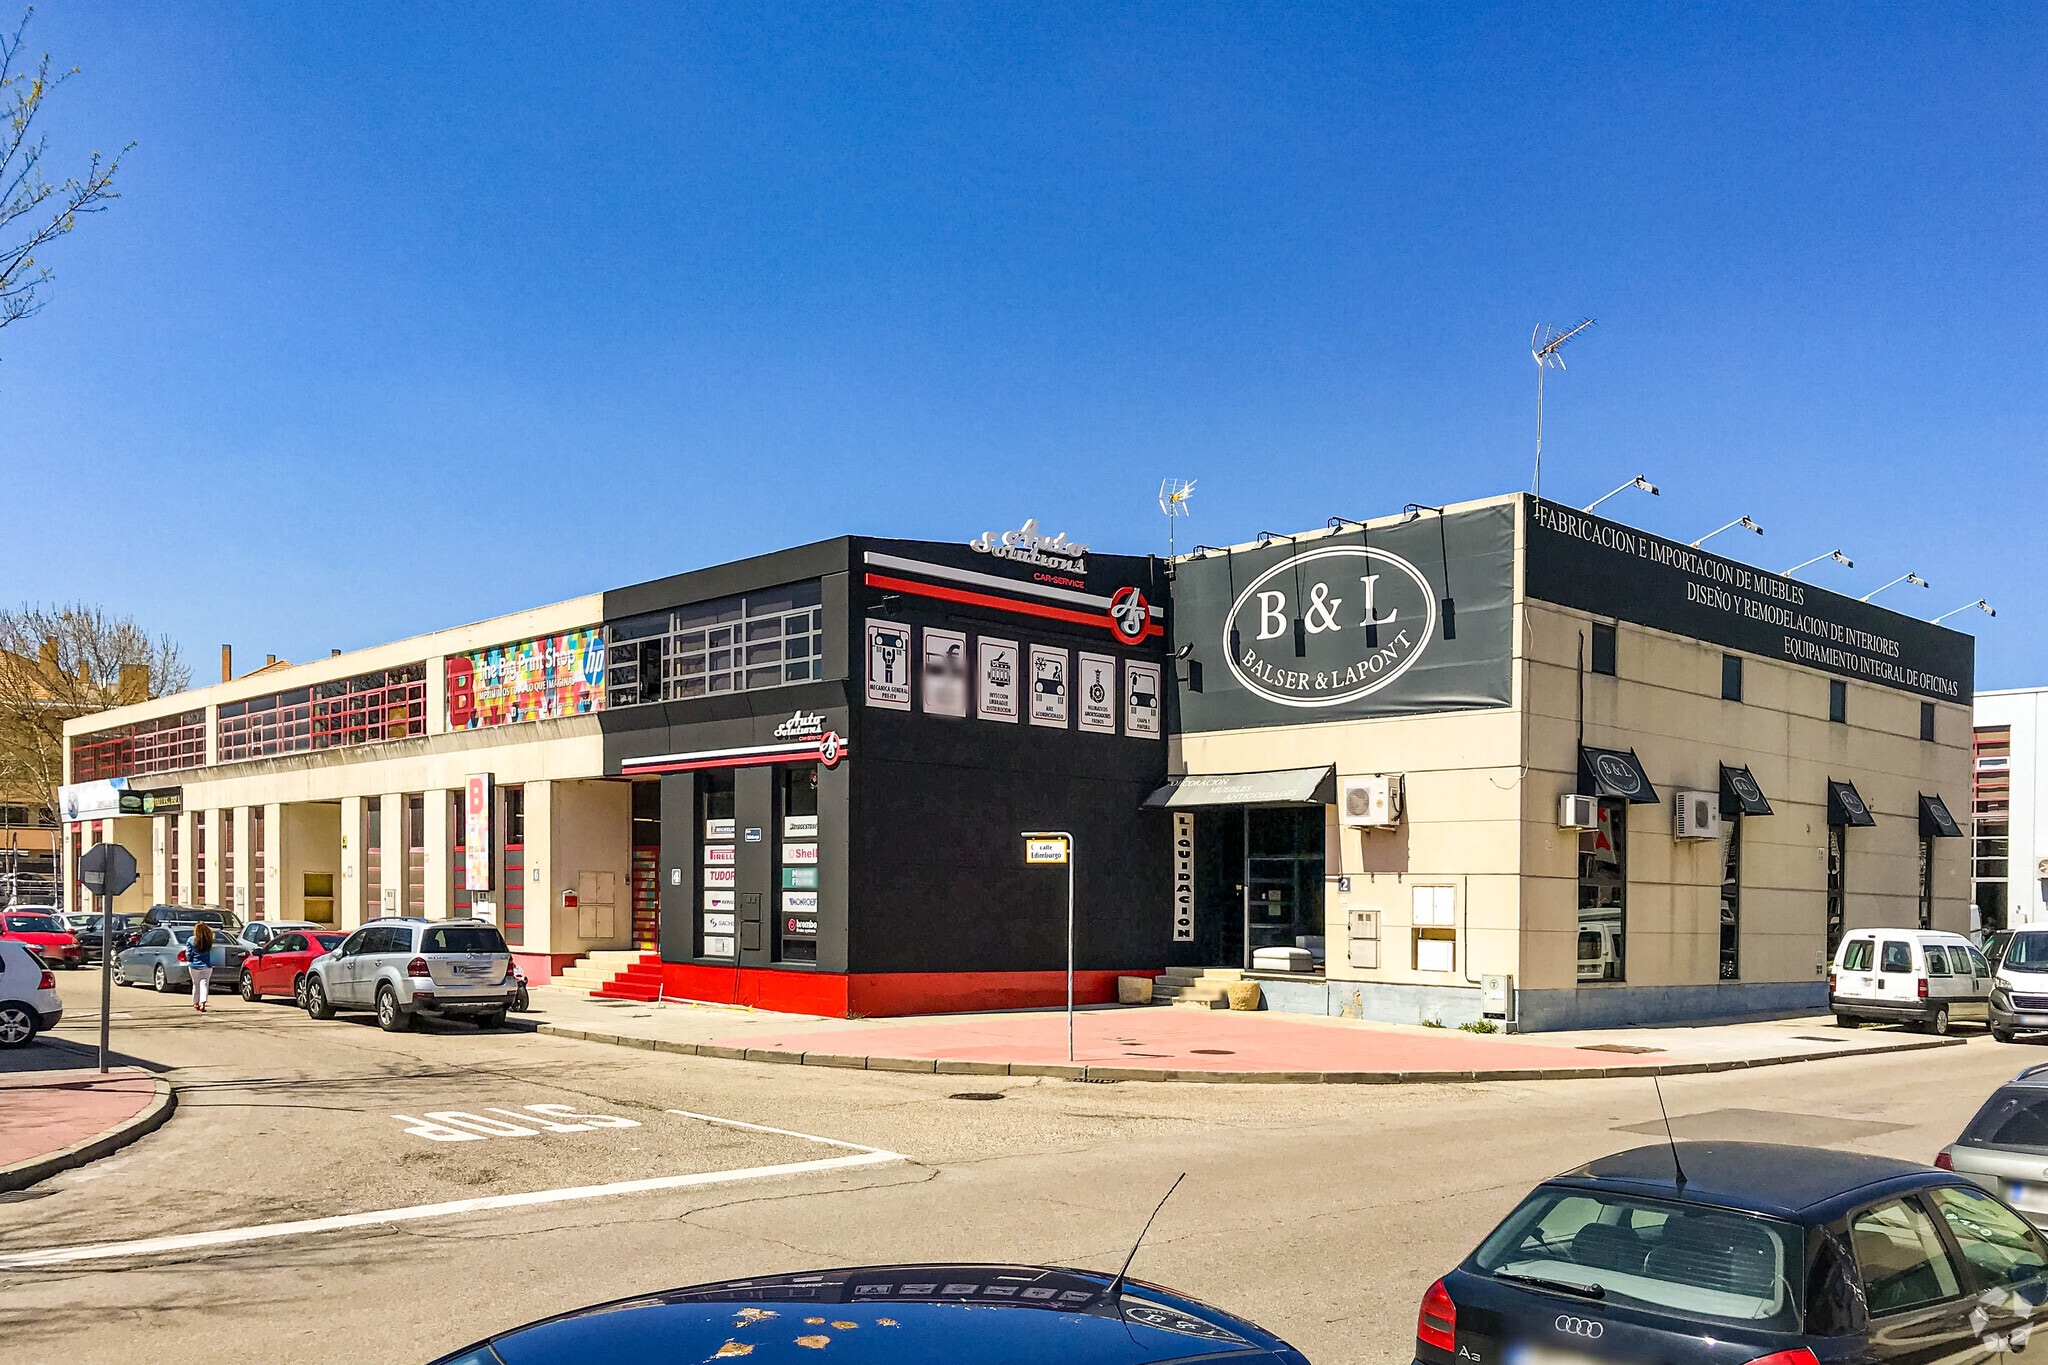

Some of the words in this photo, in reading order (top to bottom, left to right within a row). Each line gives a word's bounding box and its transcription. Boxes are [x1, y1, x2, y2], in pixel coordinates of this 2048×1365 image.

[970, 531, 1088, 574] Solutions
[1002, 518, 1090, 557] Auto
[1539, 505, 1635, 555] FABRICACION
[1639, 537, 1647, 558] E
[1650, 541, 1733, 585] IMPORTACION
[1736, 568, 1751, 590] DE
[1754, 574, 1804, 606] MUEBLES
[1033, 572, 1085, 589] CAR-SERVICE
[1256, 590, 1287, 640] B
[1304, 582, 1342, 633] &
[1360, 574, 1398, 627] L
[1687, 581, 1731, 612] DISEÑO
[1734, 594, 1743, 614] Y
[1744, 598, 1829, 638] REMODELACION
[1830, 623, 1843, 643] DE
[1846, 627, 1900, 658] INTERIORES
[478, 660, 497, 681] The
[499, 657, 517, 682] Big
[518, 651, 544, 672] Print
[545, 647, 576, 671] Shop
[585, 638, 605, 687] hp
[1241, 648, 1310, 691] BALSER
[1315, 672, 1328, 689] &
[1332, 629, 1412, 689] LAPONT
[1783, 636, 1858, 671] EQUIPAMIENTO
[1860, 656, 1905, 683] INTEGRAL
[1906, 669, 1918, 687] DE
[1919, 672, 1958, 697] OFICINAS
[534, 680, 546, 692] QUE
[774, 724, 822, 737] Solutions
[786, 710, 826, 728] Auto
[469, 778, 483, 814] B
[795, 848, 819, 859] Shell
[1177, 816, 1192, 938] LIQUIDACION
[390, 1103, 642, 1142] STOP
[1459, 1345, 1481, 1362] A3
